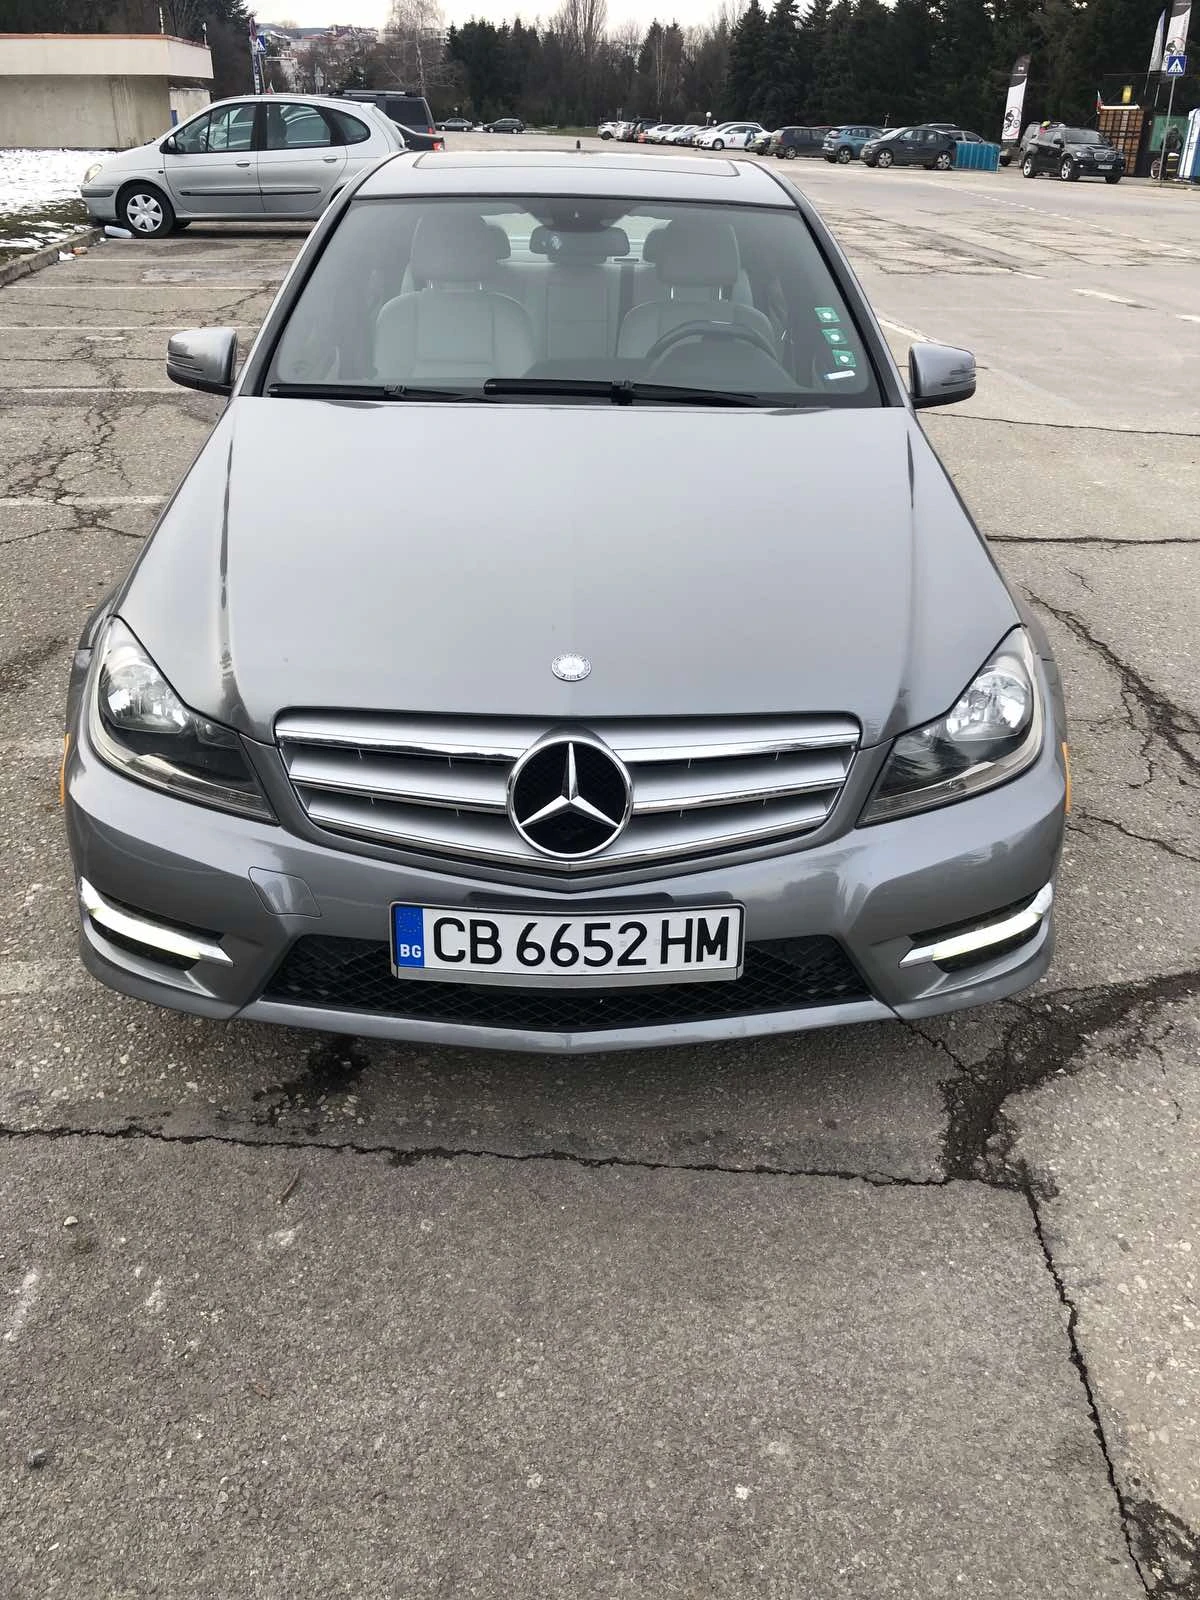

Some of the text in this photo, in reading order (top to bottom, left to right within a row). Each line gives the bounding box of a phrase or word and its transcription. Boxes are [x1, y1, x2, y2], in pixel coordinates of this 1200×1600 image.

[400, 944, 421, 958] BG
[433, 916, 729, 967] CB 6652 HM
